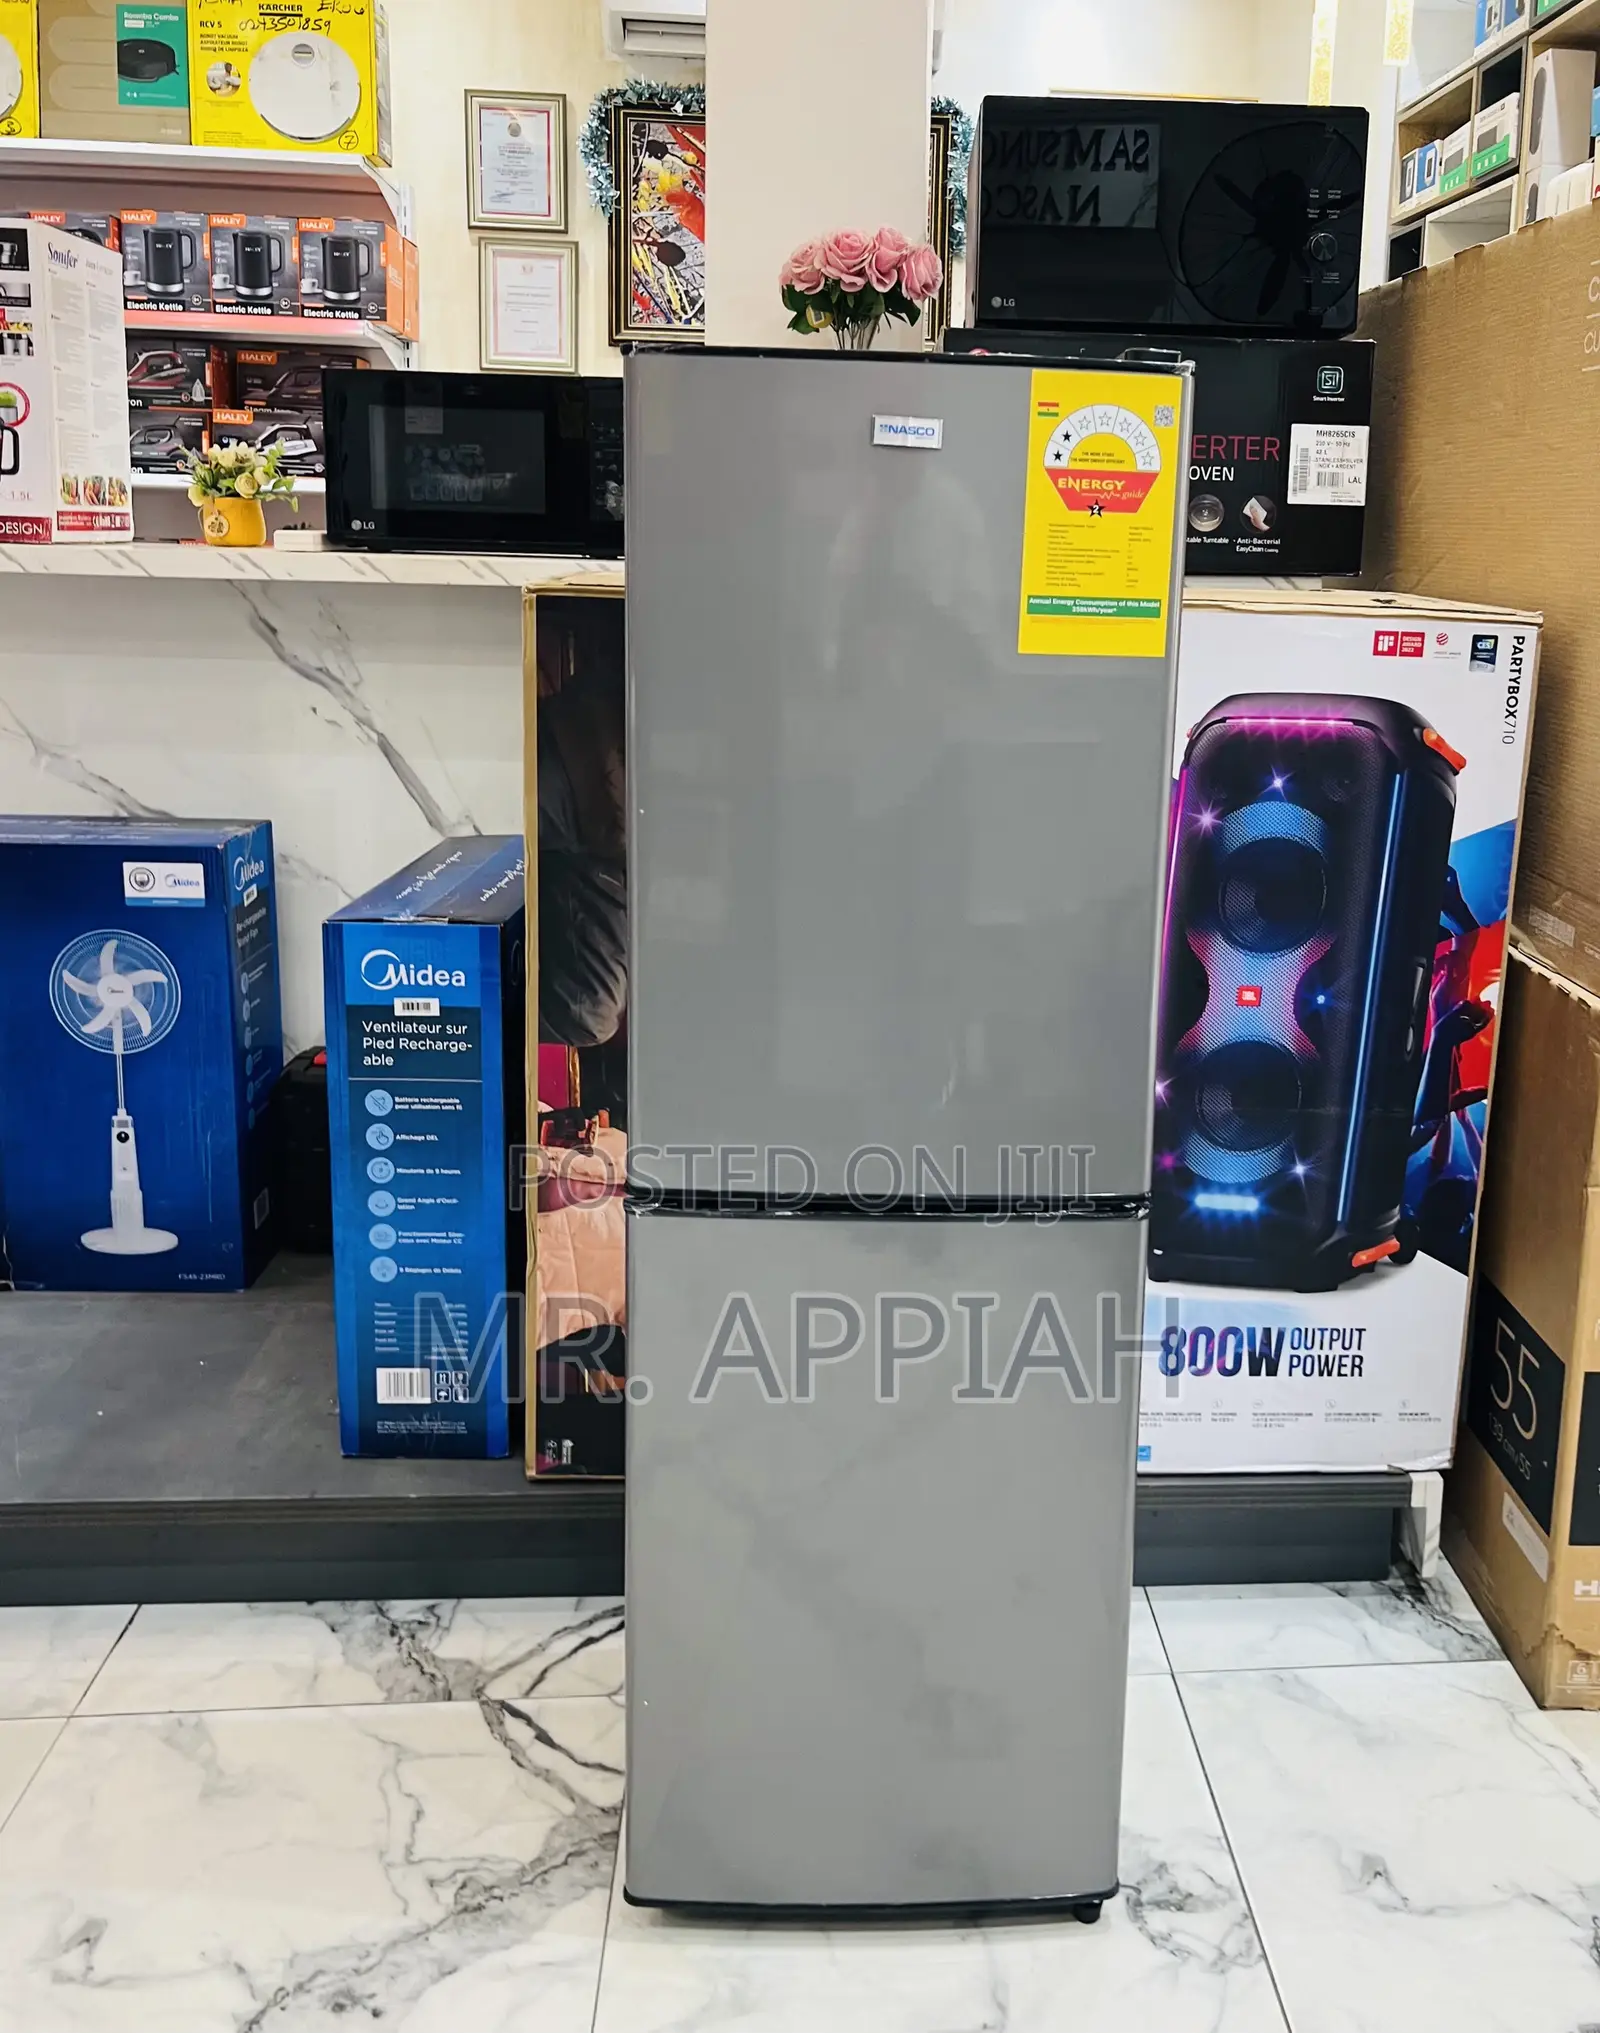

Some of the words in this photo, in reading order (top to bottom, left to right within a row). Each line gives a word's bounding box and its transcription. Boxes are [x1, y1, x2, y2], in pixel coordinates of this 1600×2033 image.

[124, 214, 152, 222] HALEY
[213, 216, 241, 225] HALEY
[302, 222, 330, 230] HALEY
[48, 241, 79, 270] Sonifer
[127, 301, 157, 311] Electric
[159, 302, 183, 312] Kettle
[1003, 299, 1015, 307] LG
[215, 305, 245, 314] Electric
[247, 306, 272, 315] Kettle
[304, 309, 333, 318] Electric
[335, 310, 360, 319] Kettle
[241, 353, 274, 362] HALEY
[216, 413, 249, 422] HALEY
[888, 425, 935, 437] NASCO
[1189, 466, 1234, 481] OVEN
[1057, 476, 1126, 492] ENERGY
[1121, 488, 1145, 501] guide
[1092, 504, 1099, 514] 2
[363, 521, 375, 530] LG
[1029, 597, 1052, 605] Annual
[1053, 598, 1074, 606] Energy
[1139, 600, 1160, 608] Model
[234, 856, 264, 891] Midea
[361, 949, 466, 991] Midea
[362, 1020, 441, 1034] Ventilateur
[446, 1024, 467, 1034] sur
[363, 1037, 394, 1049] Pied
[399, 1037, 472, 1053] Recharge-
[363, 1053, 394, 1066] able
[1290, 1327, 1366, 1351] OUTPUT
[1158, 1326, 1287, 1378] 800W
[1288, 1354, 1364, 1378] POWER
[1491, 1317, 1540, 1440] 55
